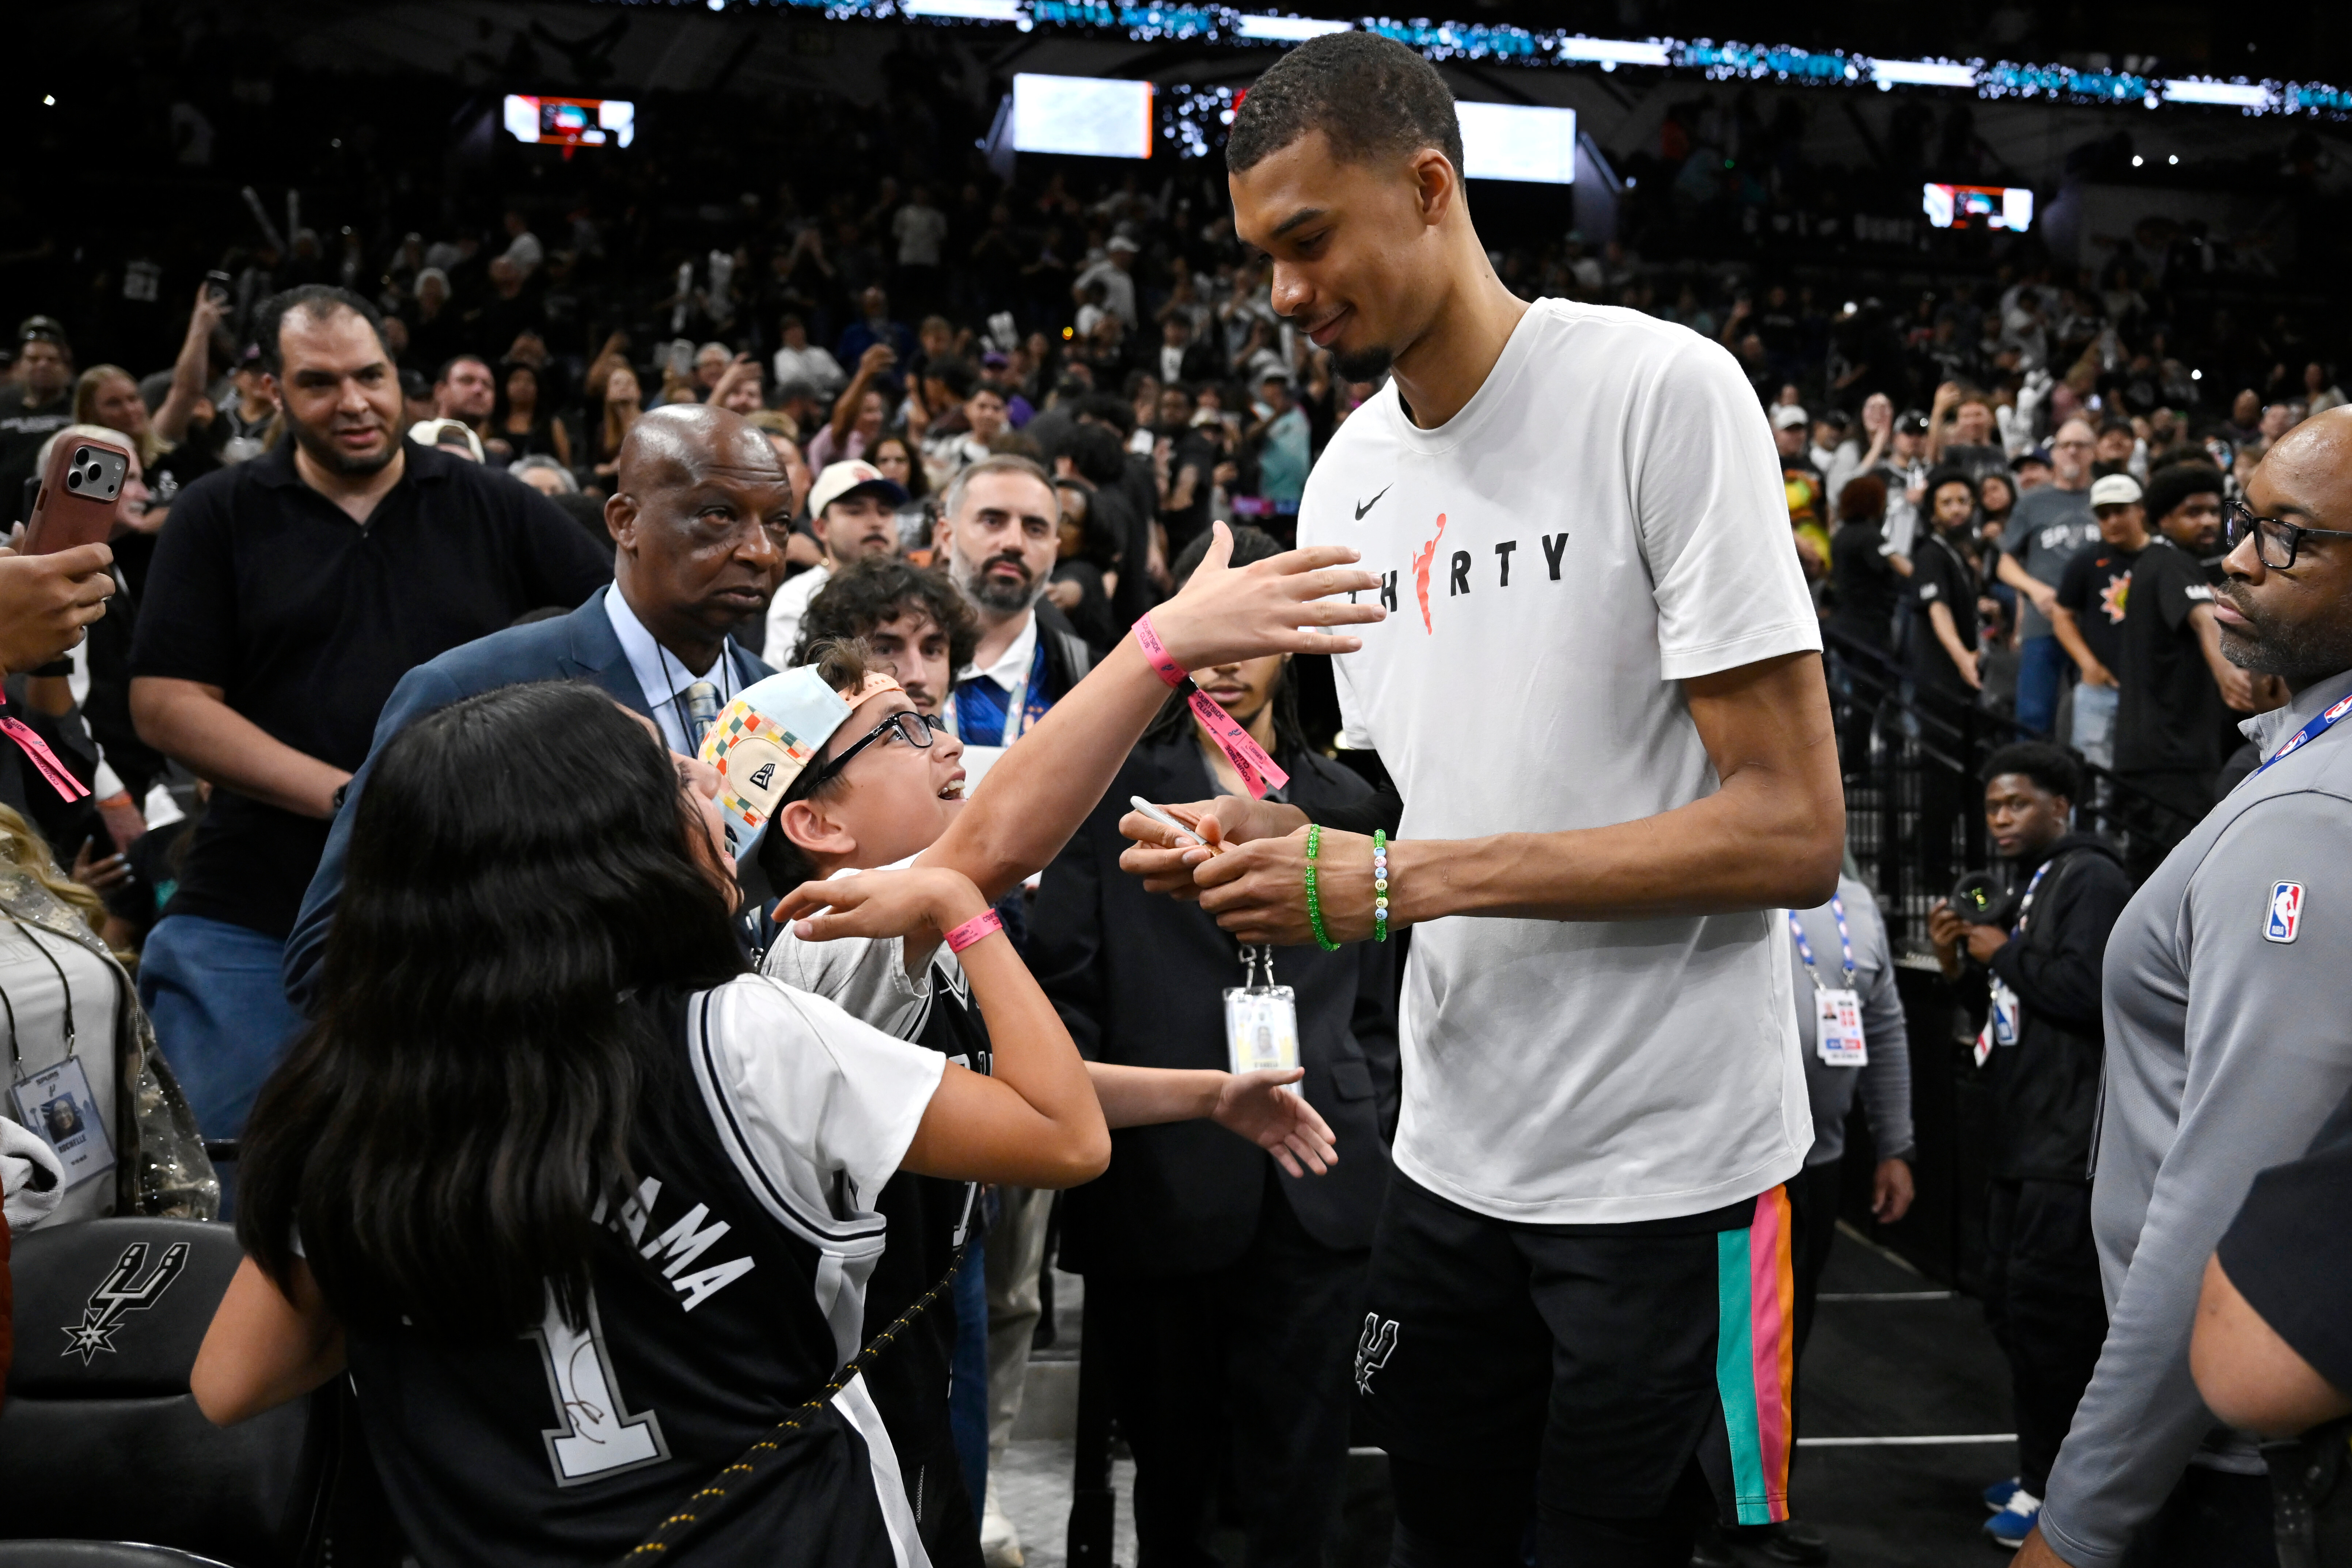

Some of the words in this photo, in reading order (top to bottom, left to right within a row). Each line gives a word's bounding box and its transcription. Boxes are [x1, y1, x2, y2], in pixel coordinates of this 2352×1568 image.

[1140, 632, 1150, 649] CLUB
[1142, 620, 1161, 653] COURTSIDE
[1196, 690, 1225, 721] COURTSIDE
[1196, 702, 1212, 718] CLUB
[1225, 744, 1251, 782] COURTSIDE
[2271, 925, 2284, 935] NBA
